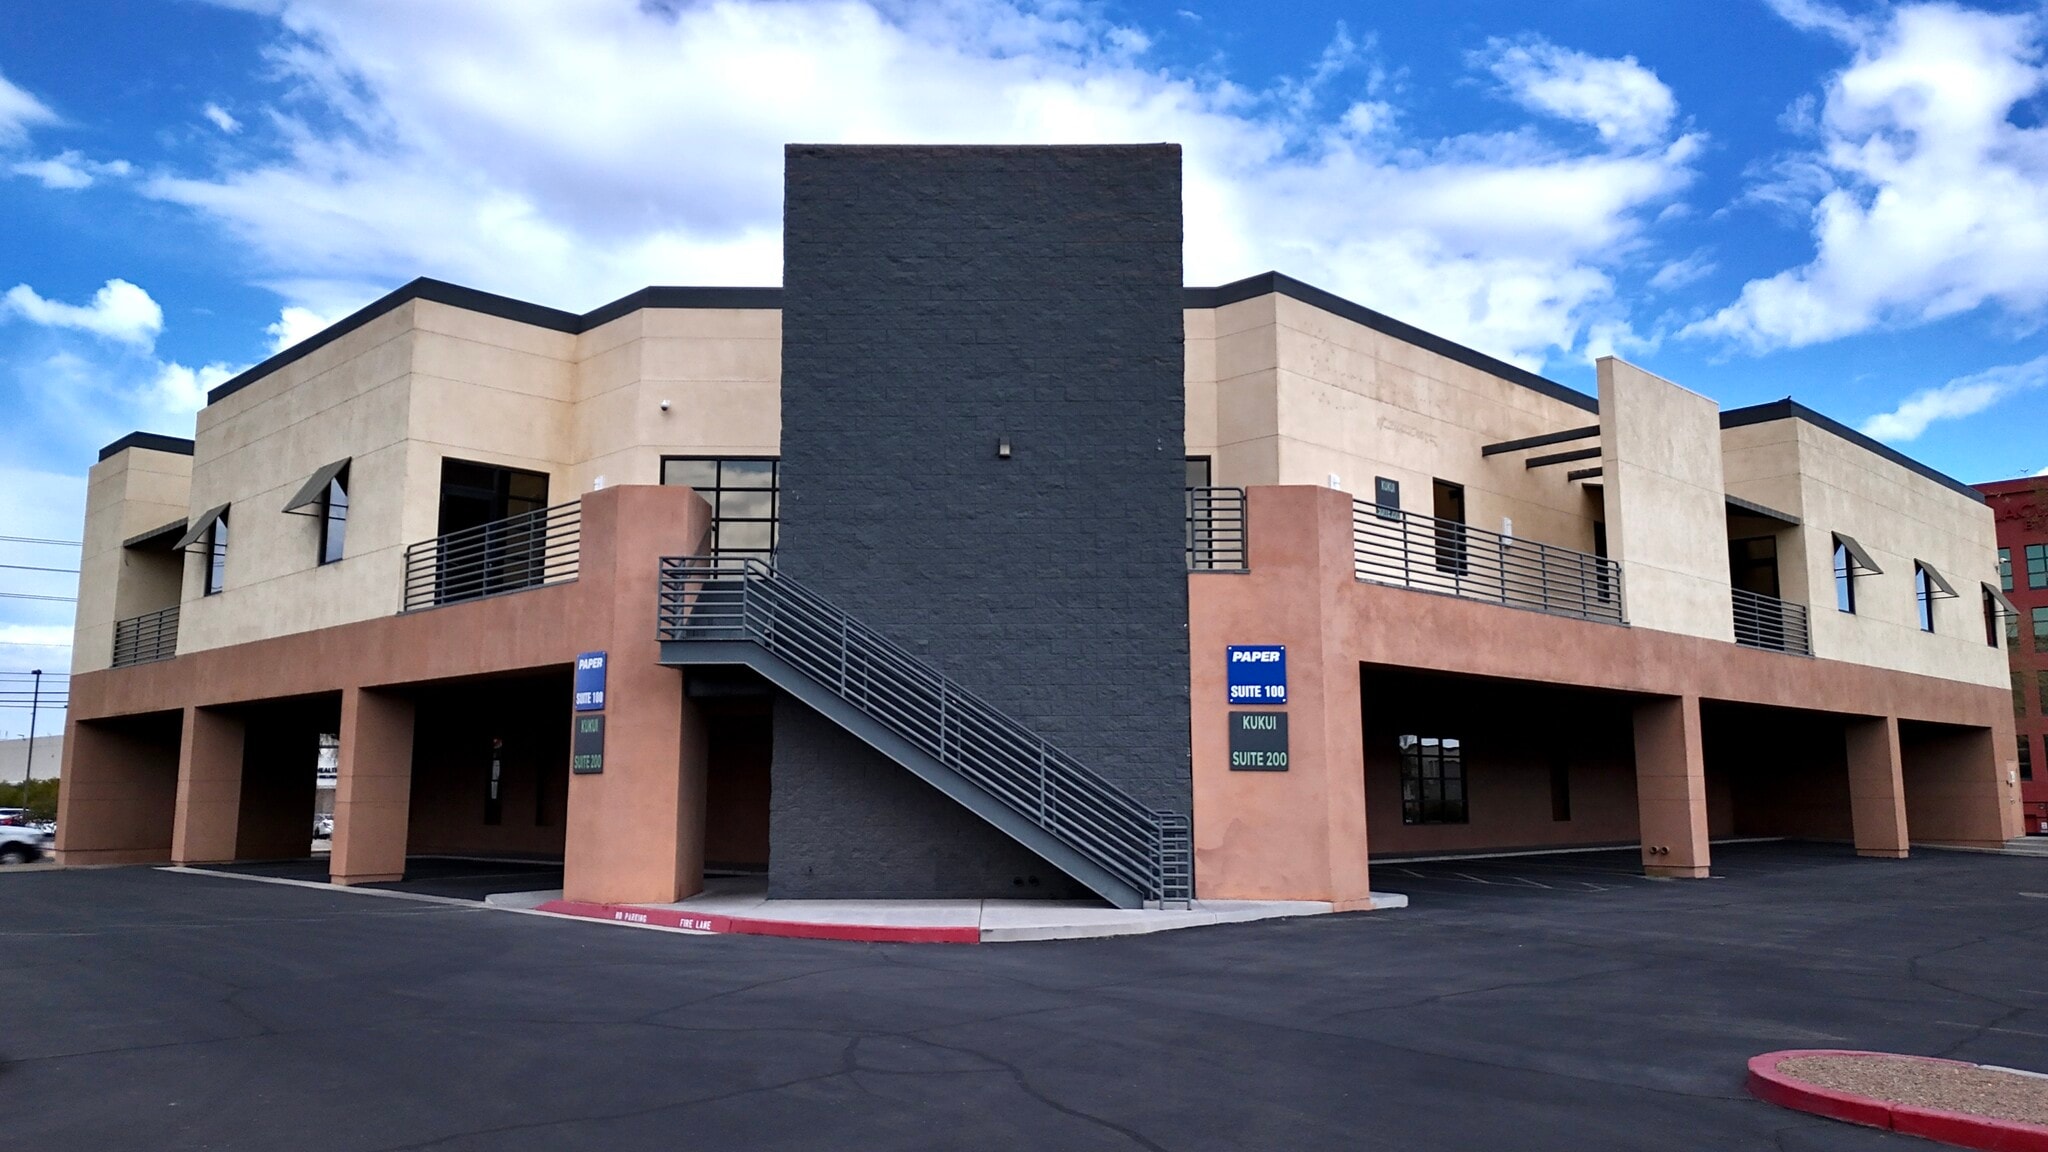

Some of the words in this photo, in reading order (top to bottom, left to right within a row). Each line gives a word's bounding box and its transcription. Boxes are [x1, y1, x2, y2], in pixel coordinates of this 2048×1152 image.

[1232, 651, 1280, 662] PAPER
[578, 657, 603, 670] PAPER
[576, 692, 591, 704] SUITE
[592, 691, 604, 703] 100
[1231, 685, 1262, 698] SUITE
[1264, 685, 1285, 698] 100
[581, 718, 599, 733] KUKUI
[1242, 715, 1276, 730] KUKUI
[574, 755, 590, 769] SUITE
[590, 754, 602, 768] 200
[1232, 751, 1264, 766] SUITE
[1266, 751, 1287, 766] 200
[615, 911, 623, 920] NO
[624, 912, 648, 923] PARKING
[680, 918, 693, 929] FIRE
[695, 919, 712, 931] LANE
